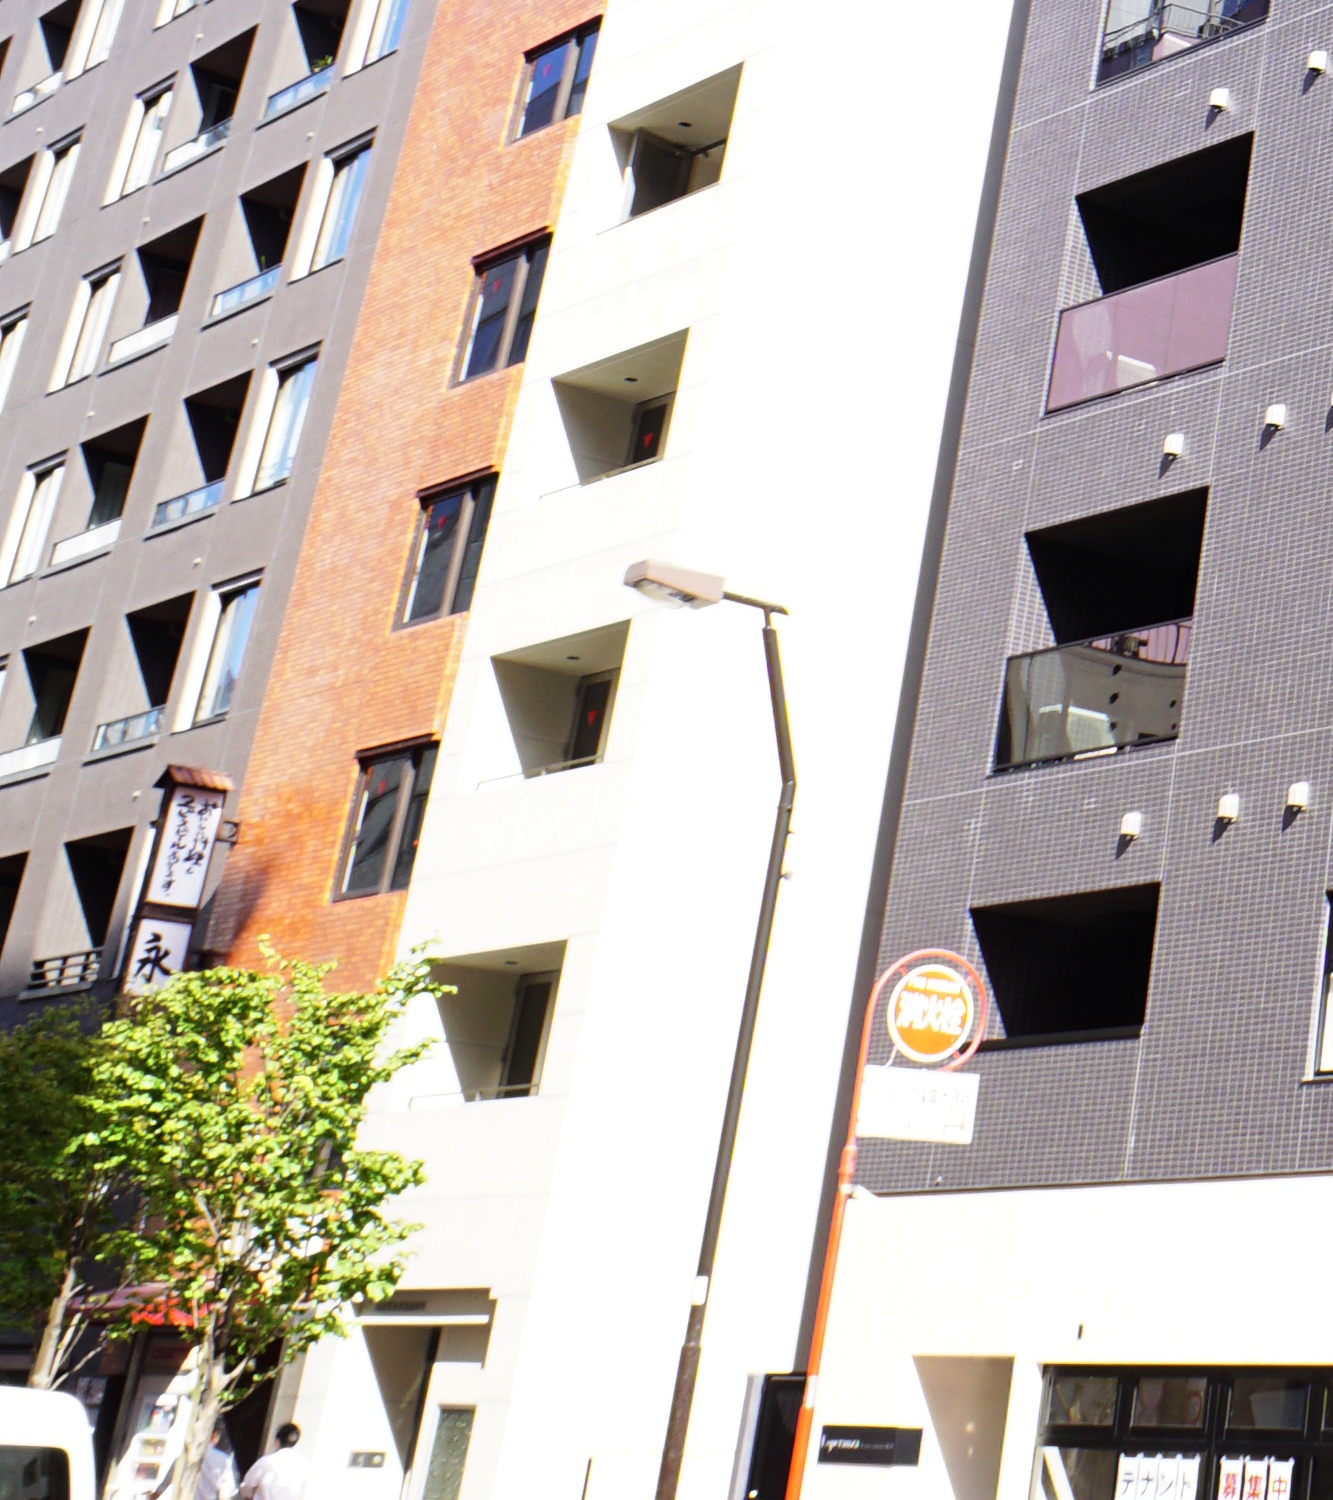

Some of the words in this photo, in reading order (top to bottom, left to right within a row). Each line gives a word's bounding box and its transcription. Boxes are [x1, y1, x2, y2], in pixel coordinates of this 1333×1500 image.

[135, 933, 172, 984] 永
[1121, 1471, 1191, 1499] テナント
